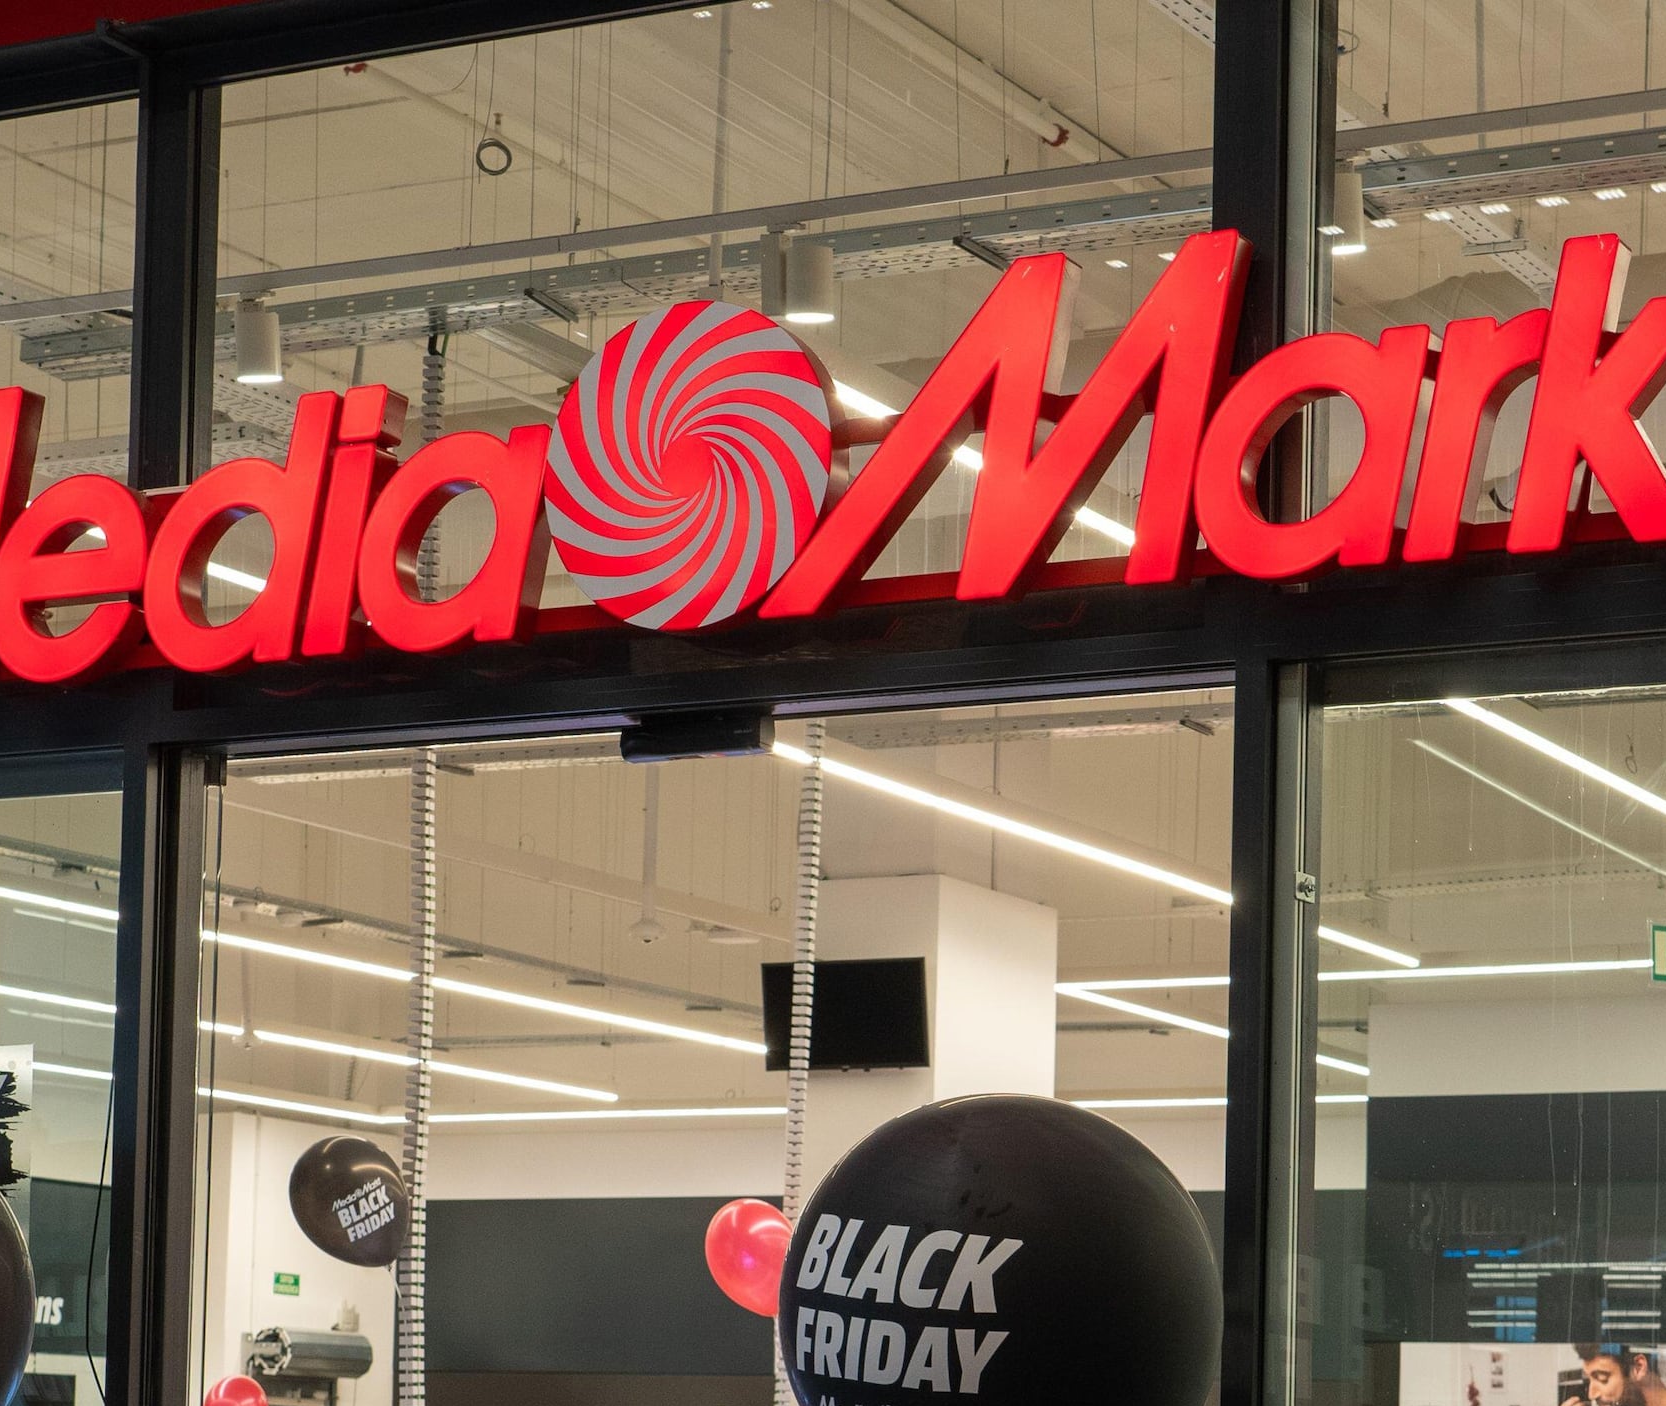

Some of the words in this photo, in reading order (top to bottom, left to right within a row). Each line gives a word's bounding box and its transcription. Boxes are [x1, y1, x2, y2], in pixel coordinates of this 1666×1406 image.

[337, 1185, 390, 1229] BLACK
[347, 1202, 396, 1243] FRIDAY
[796, 1213, 1023, 1313] BLACK
[35, 1296, 64, 1325] ns
[796, 1306, 1010, 1394] FRIDAY
